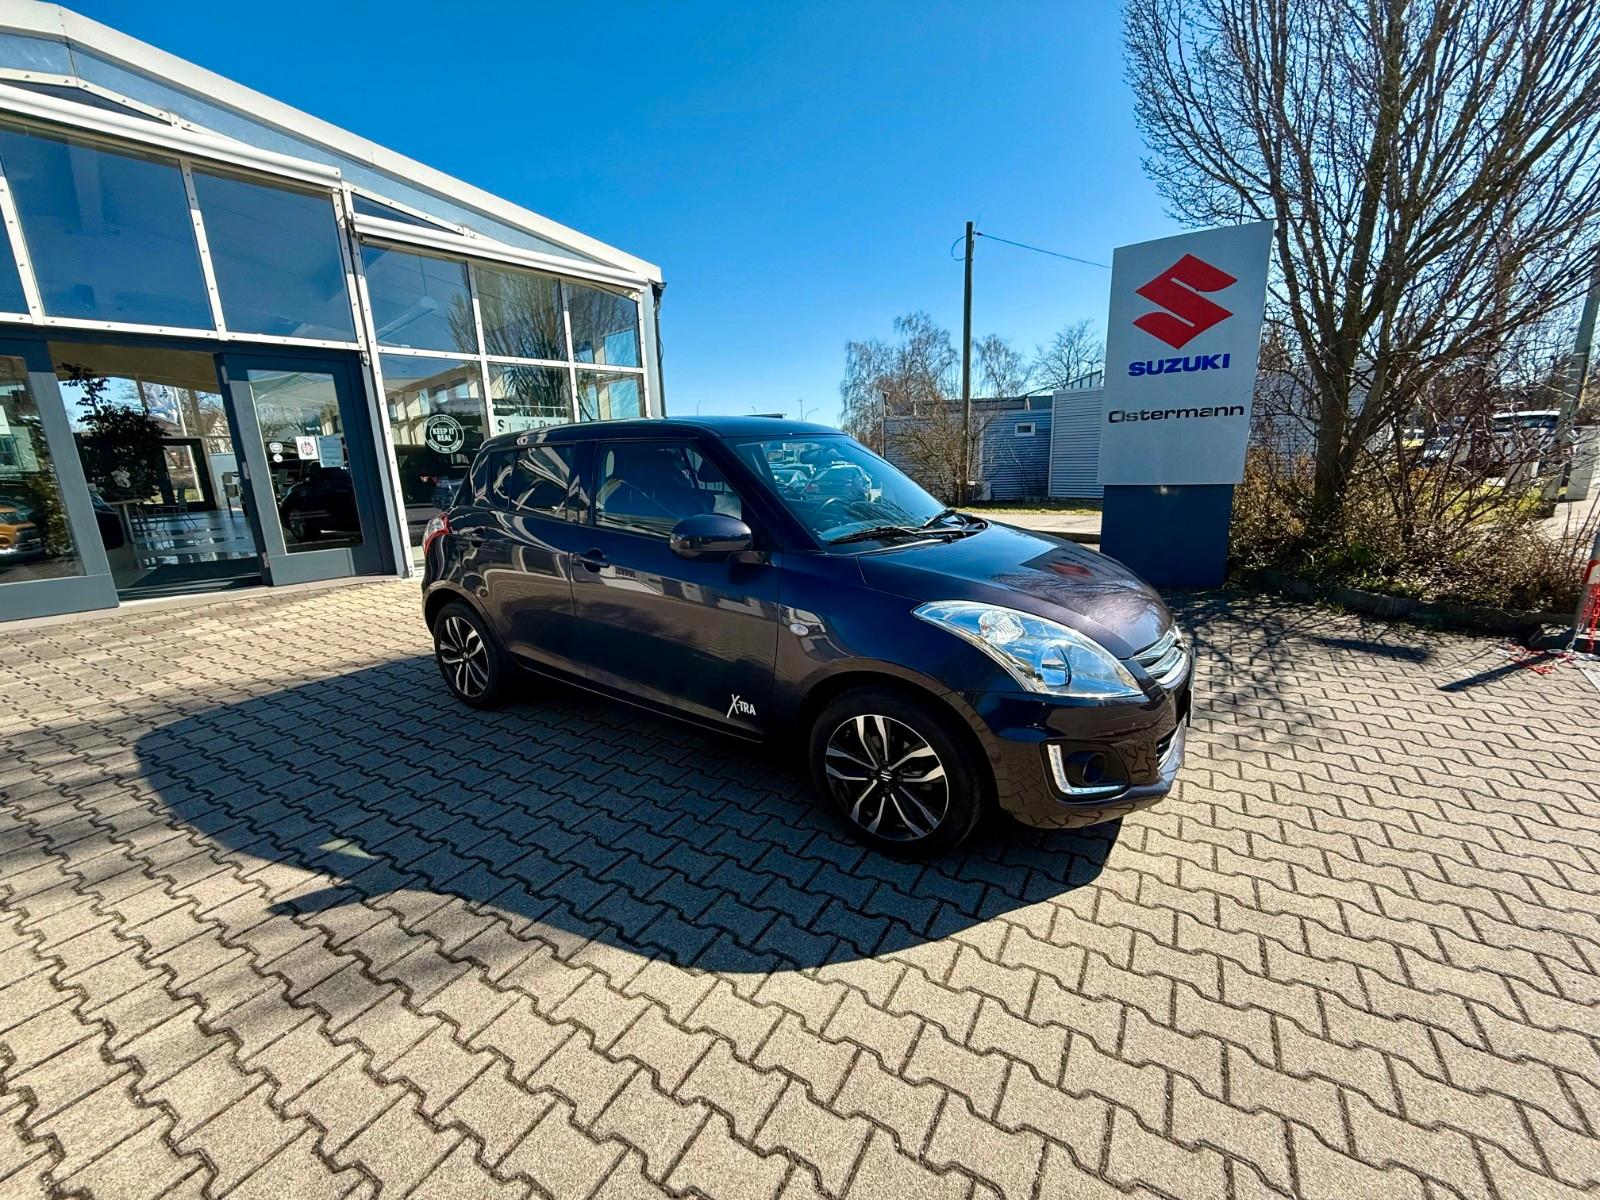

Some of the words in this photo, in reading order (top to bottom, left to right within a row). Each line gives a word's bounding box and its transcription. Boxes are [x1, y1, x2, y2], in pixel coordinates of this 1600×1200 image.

[1128, 353, 1231, 377] SUZUKI
[1108, 405, 1244, 423] Ostermann
[432, 427, 448, 435] KEEP
[448, 427, 455, 435] IT
[726, 693, 756, 719] X-TRA
